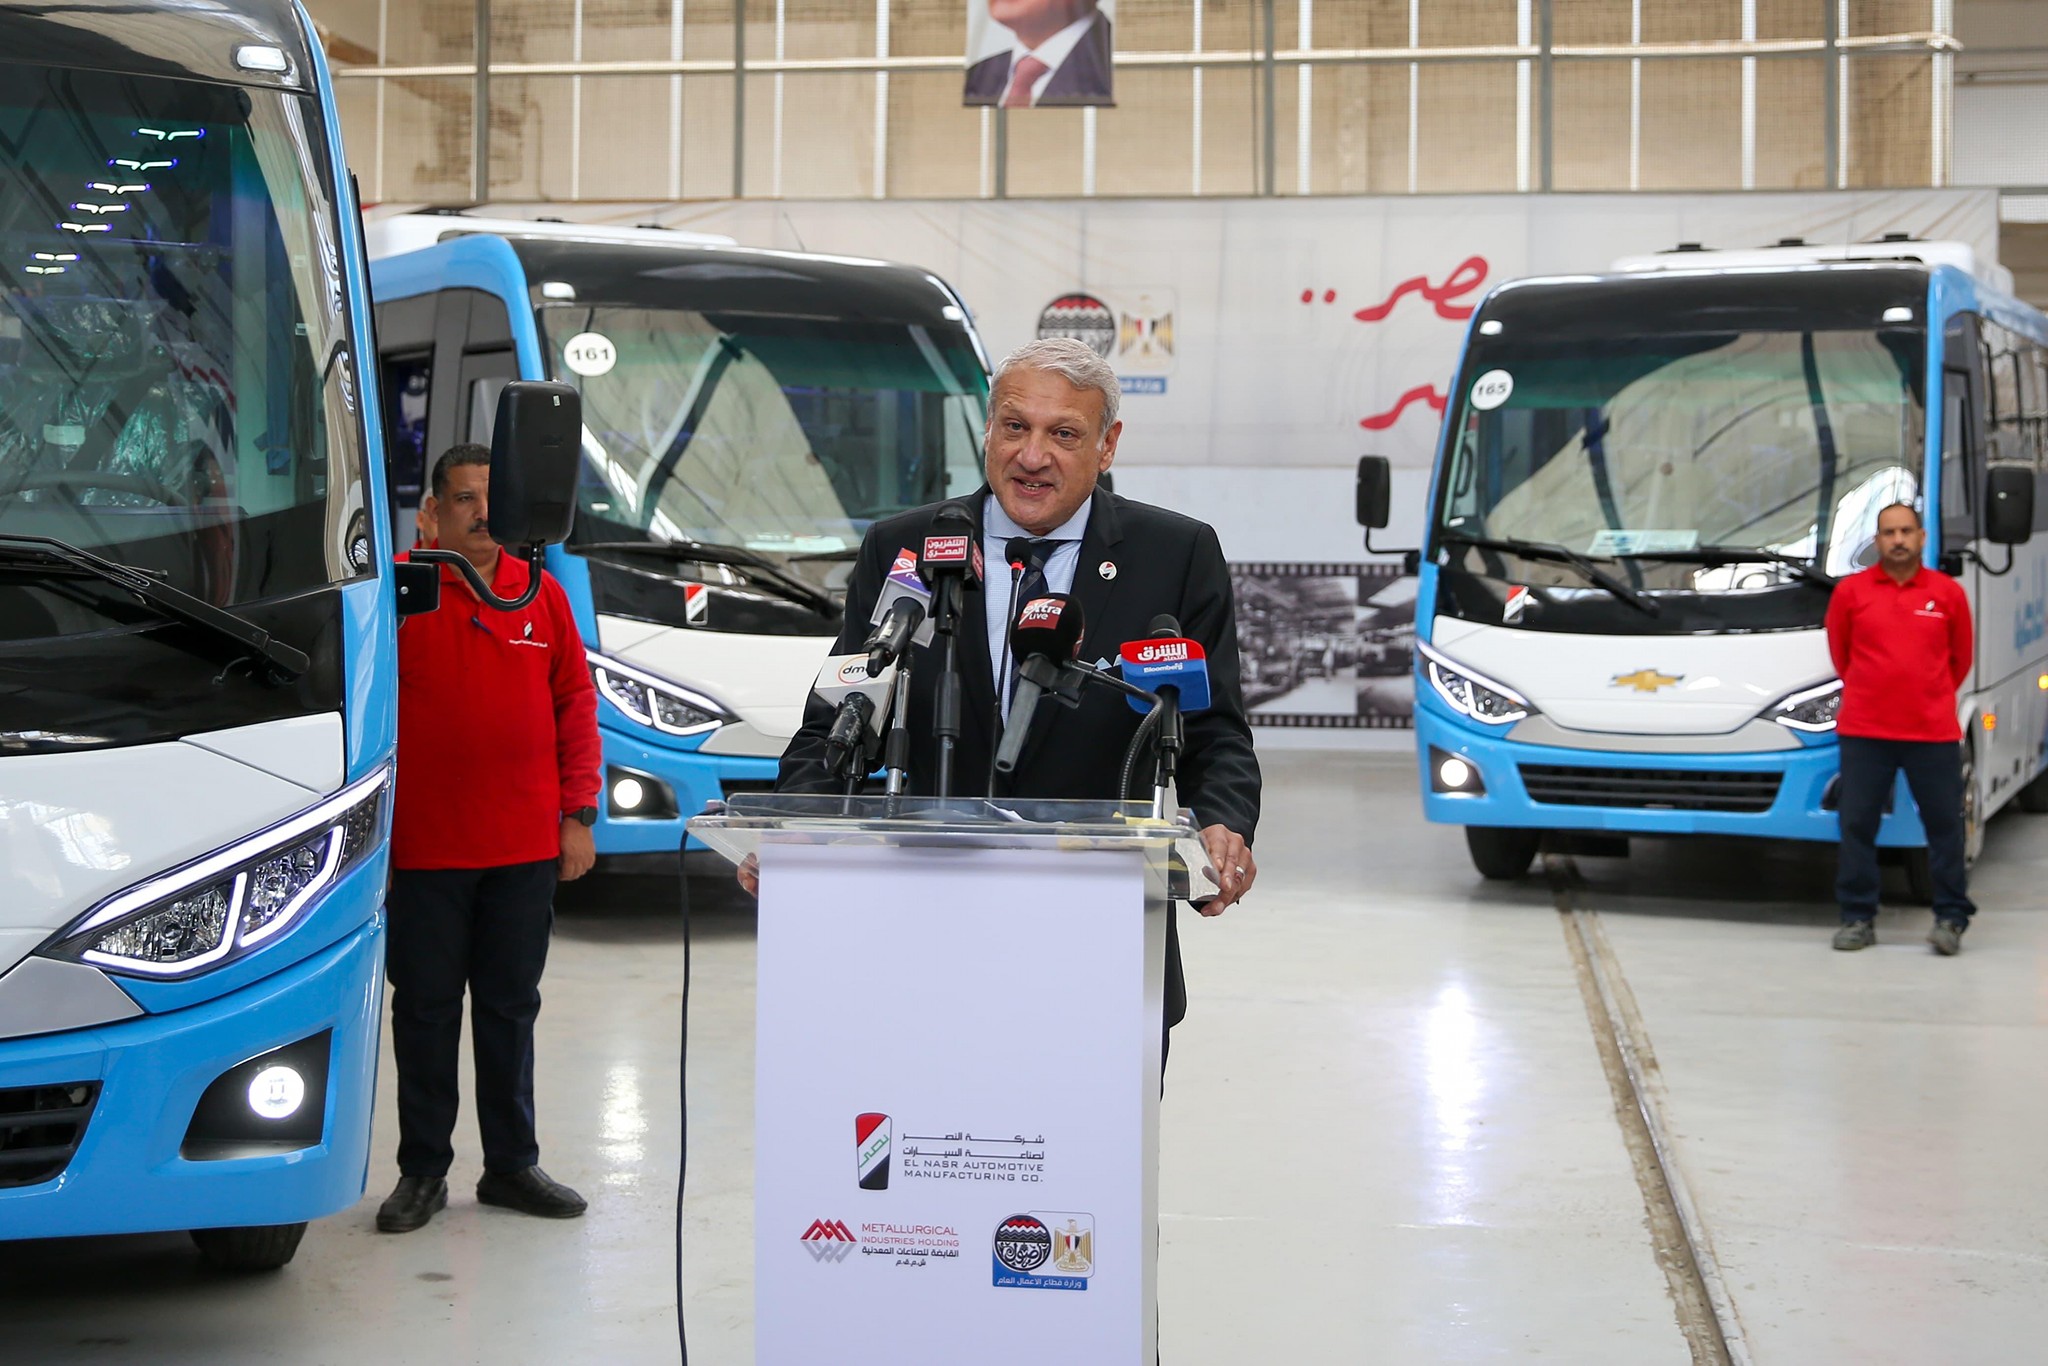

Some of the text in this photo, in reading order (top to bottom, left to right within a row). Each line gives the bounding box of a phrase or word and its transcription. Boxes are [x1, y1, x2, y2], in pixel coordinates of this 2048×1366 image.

[572, 347, 609, 361] 161
[1478, 382, 1507, 397] 165
[927, 539, 965, 549] التلفزيون
[1137, 643, 1188, 662] الشرق
[842, 665, 866, 675] dm
[1143, 662, 1184, 674] Bloomberg
[902, 1132, 1045, 1145] شركة النصر
[903, 1146, 1045, 1160] لصناعة السيارات
[904, 1159, 1044, 1172] EL NASR AUTOMOTIVE
[904, 1170, 1044, 1183] MANUFACTURING CO.
[861, 1223, 959, 1236] METALLURGICAL
[861, 1236, 960, 1247] INDUSTRIES HOLDING
[861, 1246, 959, 1259] القابضة للصناعات المعدنية
[997, 1276, 1016, 1286] العام
[1064, 1280, 1082, 1289] وزارة
